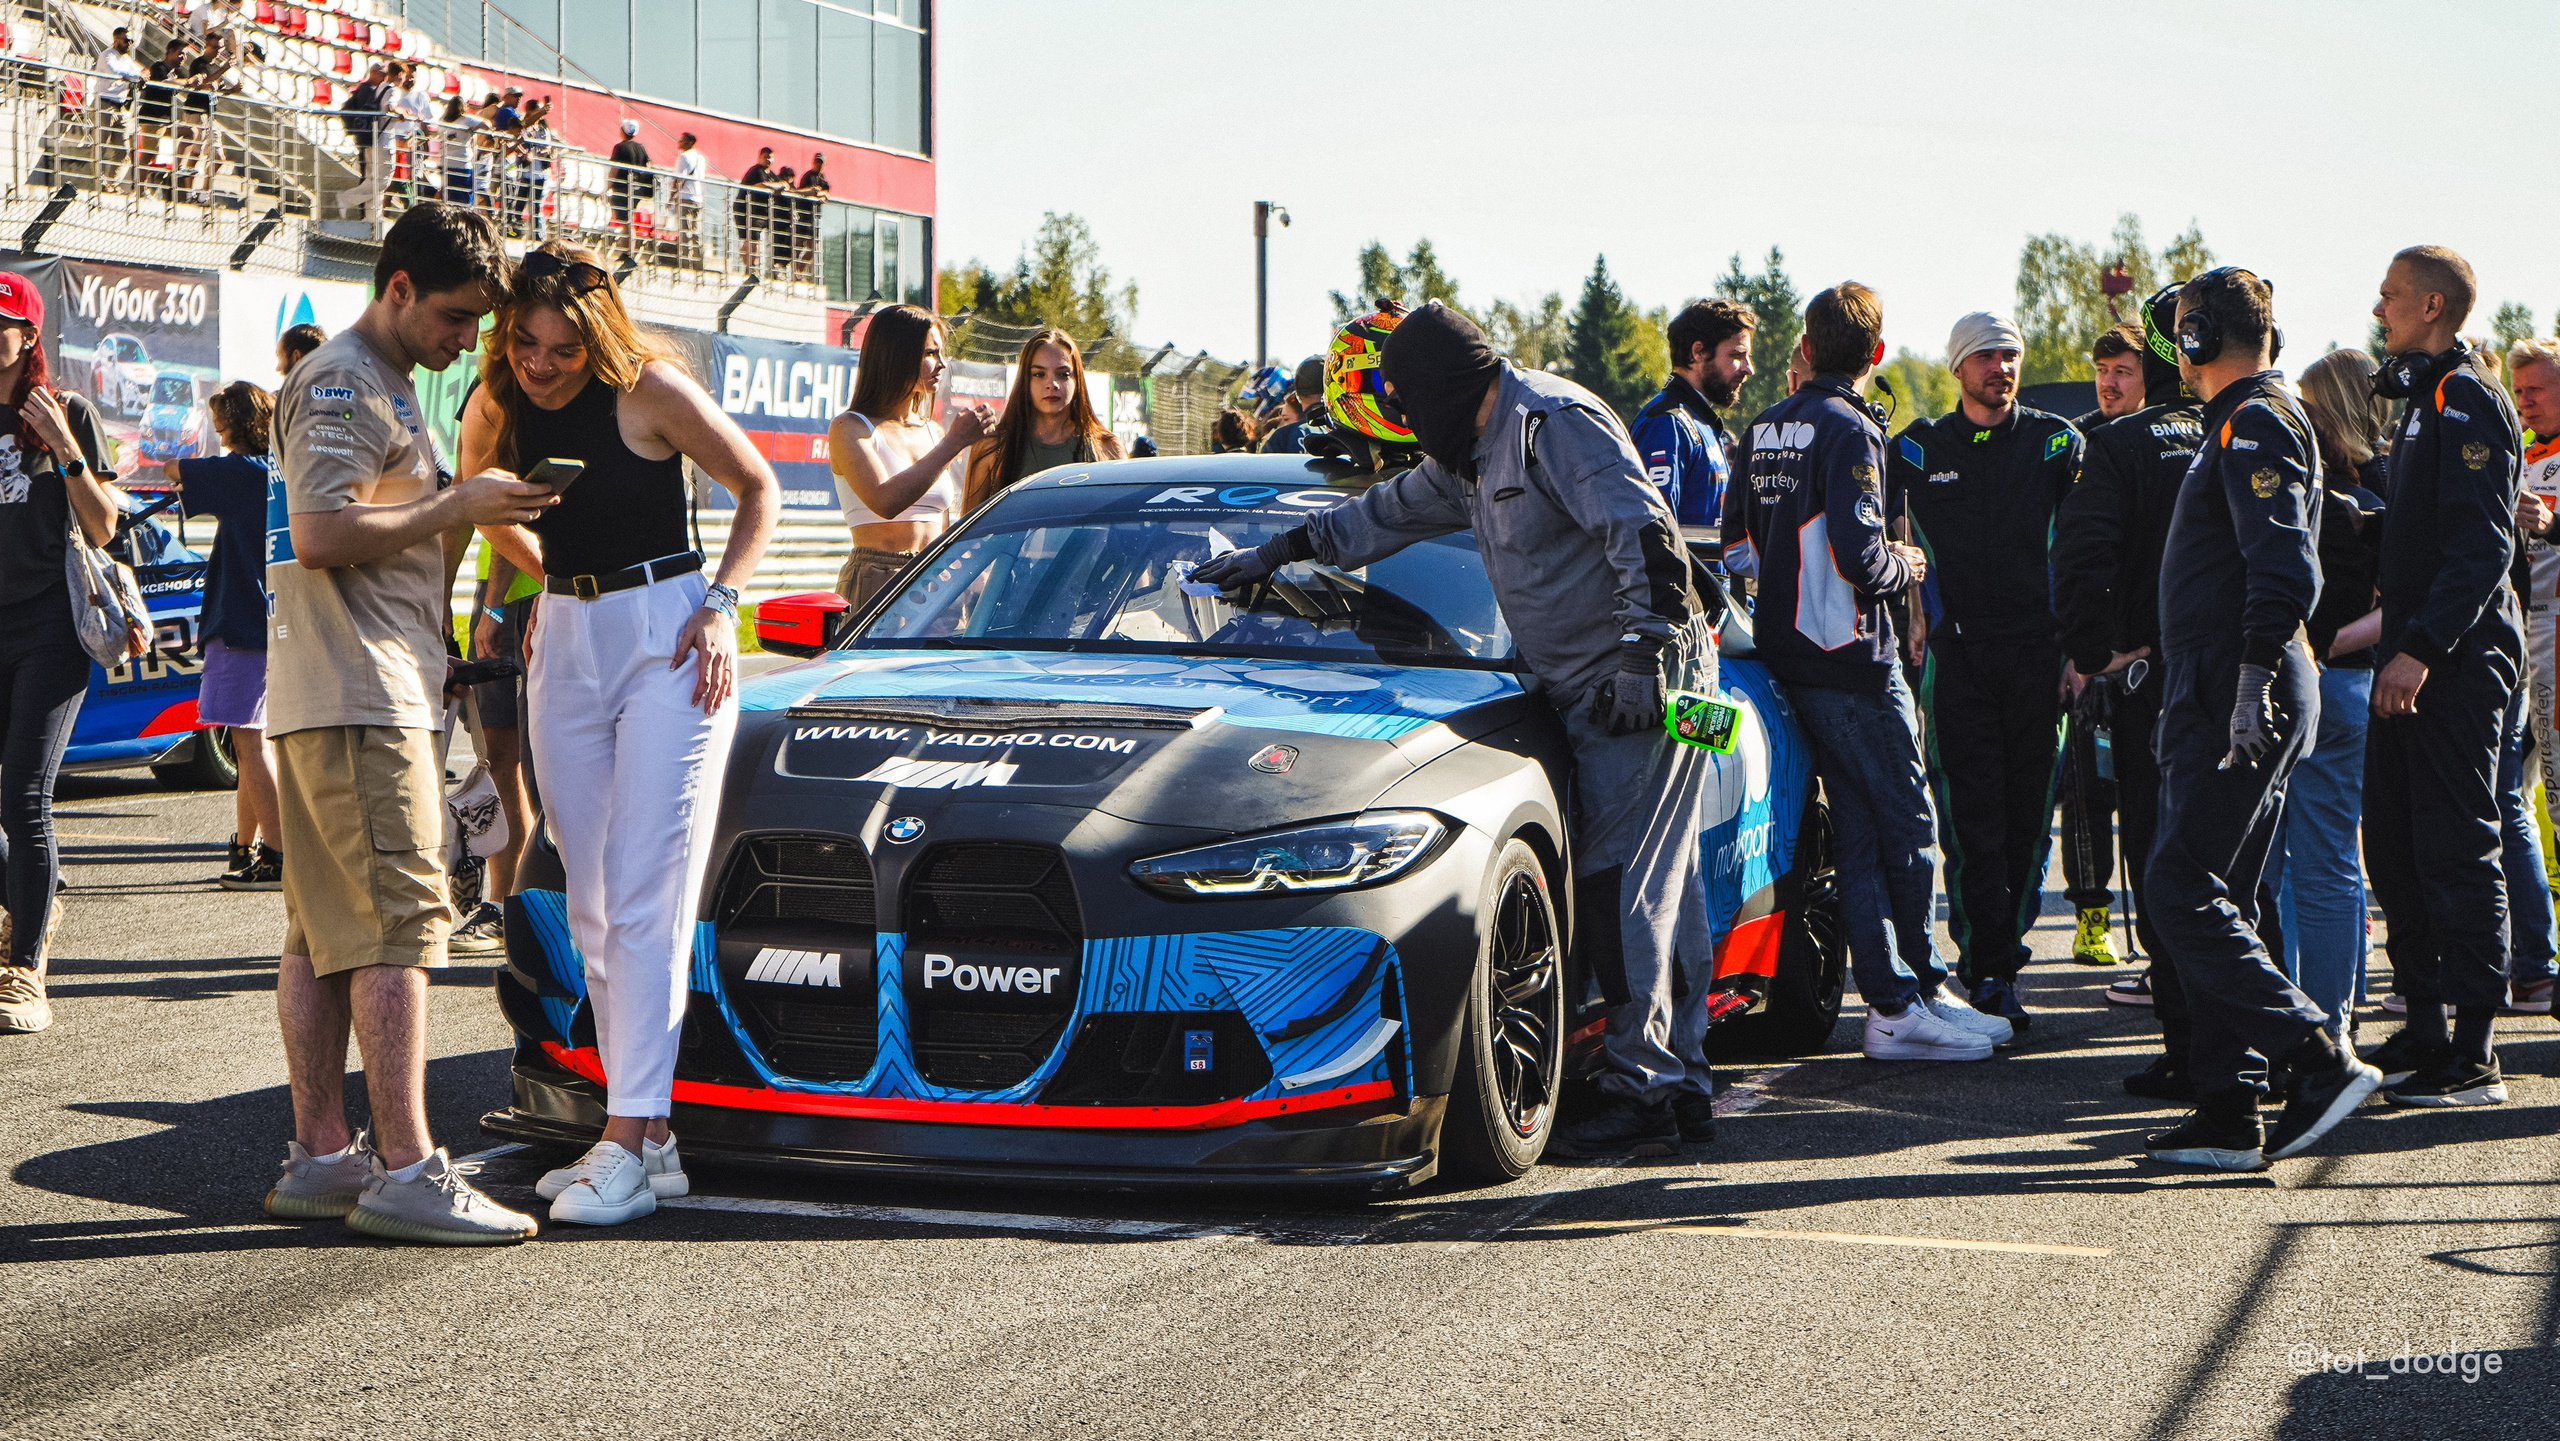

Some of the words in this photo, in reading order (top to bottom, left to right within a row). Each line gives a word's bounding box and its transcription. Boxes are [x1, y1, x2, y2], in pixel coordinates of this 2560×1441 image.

[79, 275, 159, 328] Кубок
[160, 282, 206, 326] 330
[324, 387, 353, 401] BWT
[722, 354, 860, 420] BALCHU
[316, 424, 346, 432] RENAULT
[2150, 421, 2194, 437] BMW
[308, 430, 354, 442] E-TECH
[140, 579, 192, 594] КСЕНОВ
[924, 954, 1059, 994] Power
